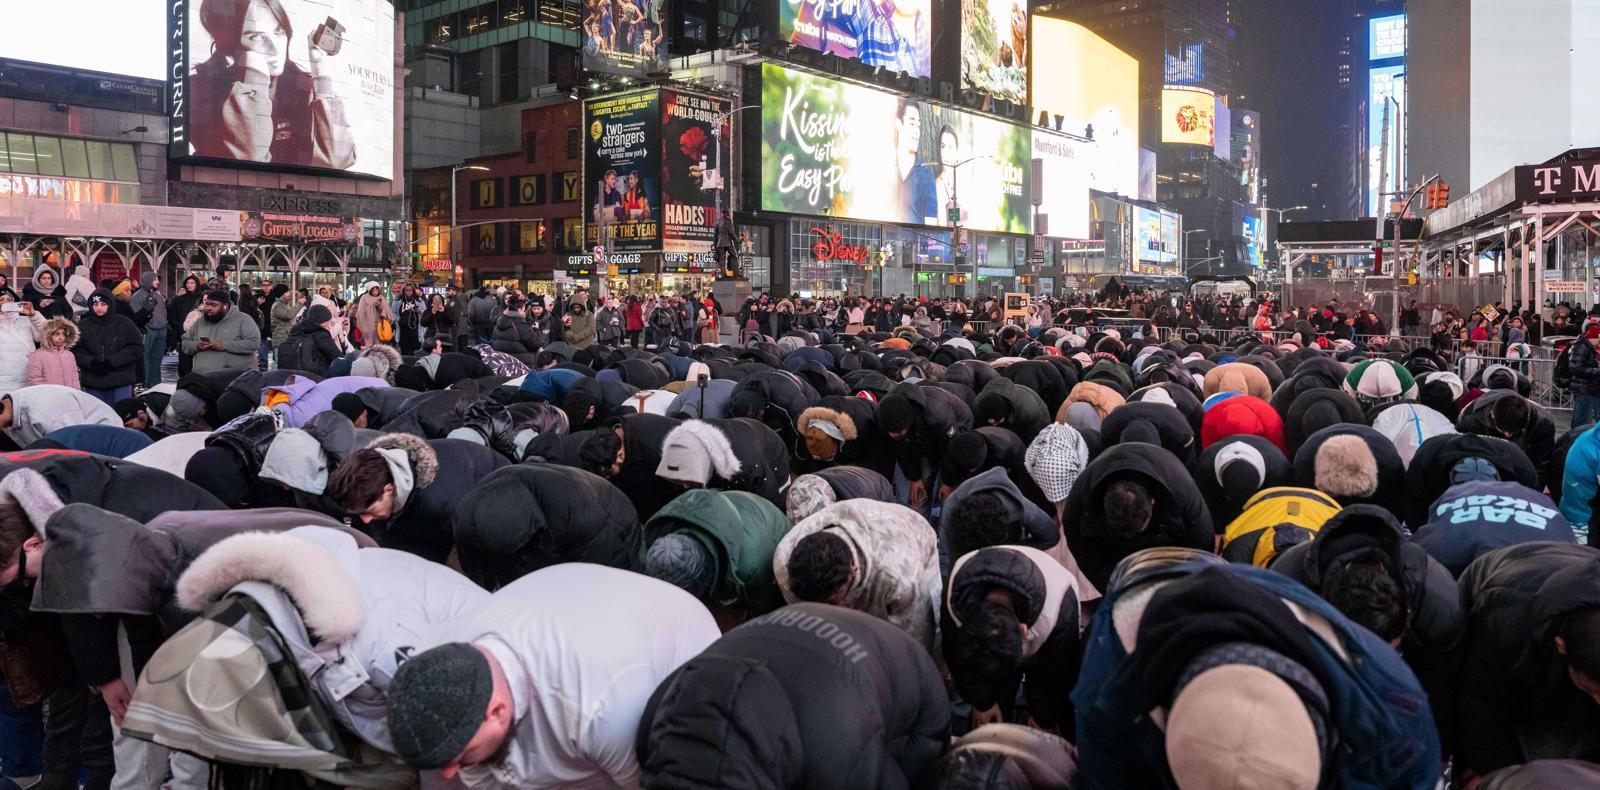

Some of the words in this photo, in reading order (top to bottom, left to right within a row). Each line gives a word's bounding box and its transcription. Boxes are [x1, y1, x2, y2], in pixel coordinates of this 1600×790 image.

[173, 41, 183, 117] TURN
[676, 95, 689, 106] COME
[691, 98, 700, 108] SEE
[701, 100, 711, 110] HOW
[712, 102, 720, 111] THE
[667, 103, 693, 119] WORLD
[695, 109, 718, 123] COULD
[780, 86, 850, 155] Kissin
[173, 125, 183, 144] II
[606, 123, 622, 136] two
[602, 131, 645, 148] strangers
[1034, 137, 1058, 154] Mumford
[634, 149, 643, 159] york
[779, 153, 822, 206] Easy
[261, 196, 340, 212] EXPRESS
[262, 221, 293, 237] GIFTS
[301, 222, 344, 238] LUGGAGE
[588, 224, 607, 239] BET
[608, 225, 618, 239] OF
[620, 224, 635, 238] THE
[637, 223, 657, 237] YEAR
[568, 255, 593, 265] GIFTS
[604, 254, 641, 264] GGAGE
[664, 253, 688, 262] GIFTS
[742, 610, 868, 663] HOODRIC
